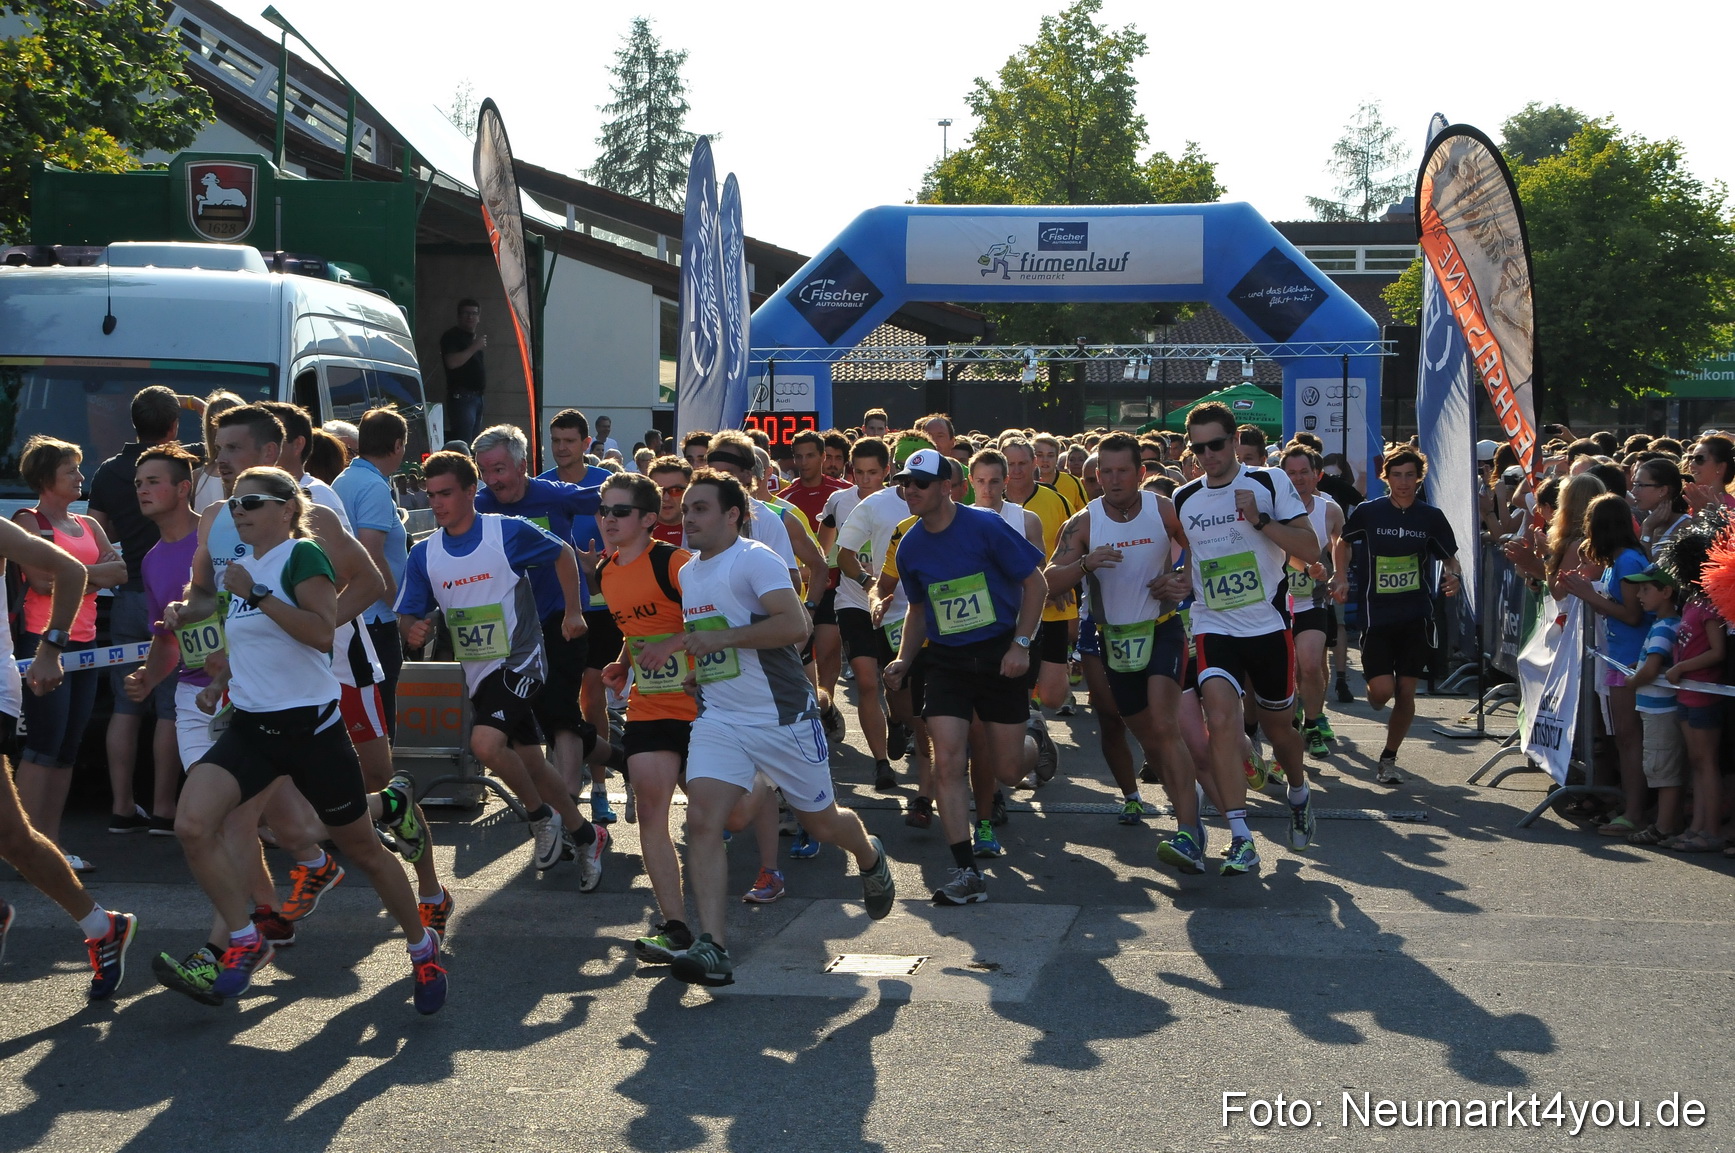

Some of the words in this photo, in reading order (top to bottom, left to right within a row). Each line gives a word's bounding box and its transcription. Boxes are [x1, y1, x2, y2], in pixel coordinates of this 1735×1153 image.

[207, 222, 237, 234] 1628
[1048, 233, 1085, 241] Fischer
[1020, 251, 1131, 272] firmenlauf
[810, 288, 869, 301] Fischer
[1376, 527, 1399, 536] EURO
[1405, 529, 1427, 539] POLES
[1116, 538, 1154, 548] KLEBL
[454, 572, 494, 587] KLEBL
[1204, 570, 1259, 600] 1433
[1378, 571, 1418, 588] 5087
[688, 603, 718, 615] KLEBL
[939, 593, 981, 621] 721
[181, 625, 220, 654] 610
[457, 623, 495, 648] 547
[1111, 637, 1146, 660] 517
